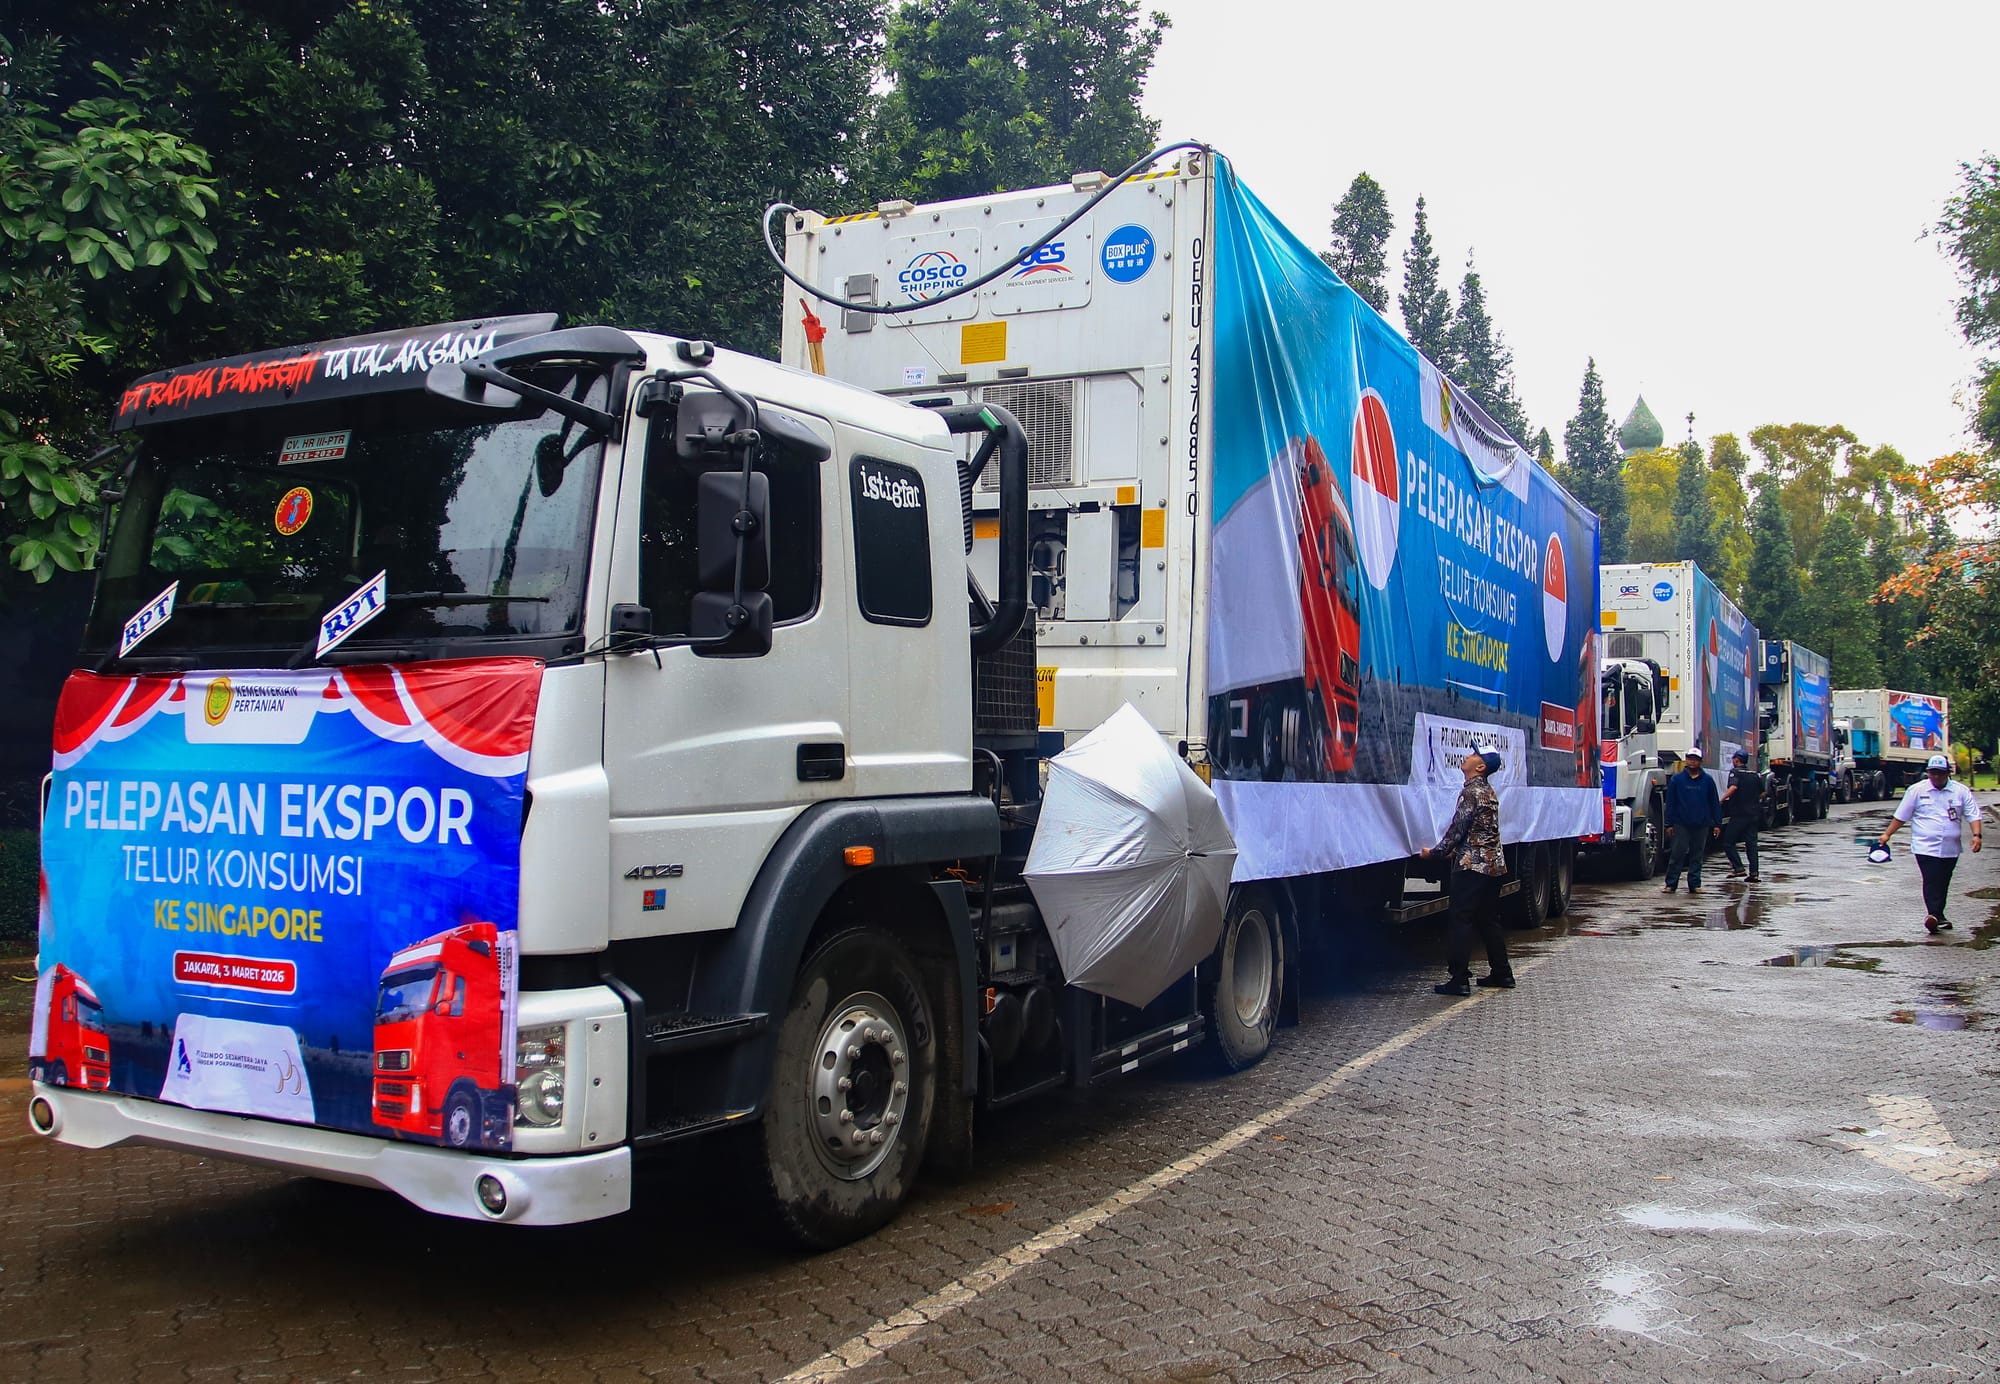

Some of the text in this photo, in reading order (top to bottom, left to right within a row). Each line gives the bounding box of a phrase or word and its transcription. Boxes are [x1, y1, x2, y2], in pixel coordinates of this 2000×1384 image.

[1107, 243, 1146, 258] BOX PLUS
[898, 264, 967, 283] COSCO
[900, 279, 964, 293] SHIPPING
[1191, 238, 1201, 328] OERU
[1188, 343, 1199, 482] 437685
[302, 438, 315, 449] HR
[860, 465, 921, 508] istigfar
[1406, 449, 1538, 584] PELEPASAN EKSPOR
[1438, 555, 1471, 608] TELUR
[124, 596, 170, 646] RPT
[323, 585, 379, 642] RPT
[1446, 621, 1459, 658] KE
[233, 699, 285, 712] PERTANIAN
[64, 781, 474, 845] PELEPASAN EKSPOR
[122, 845, 363, 896] TELUR KONSUMSI
[154, 899, 323, 943] KE SINGAPORE
[183, 960, 286, 983] JAKARTA, 3 MARET 2026
